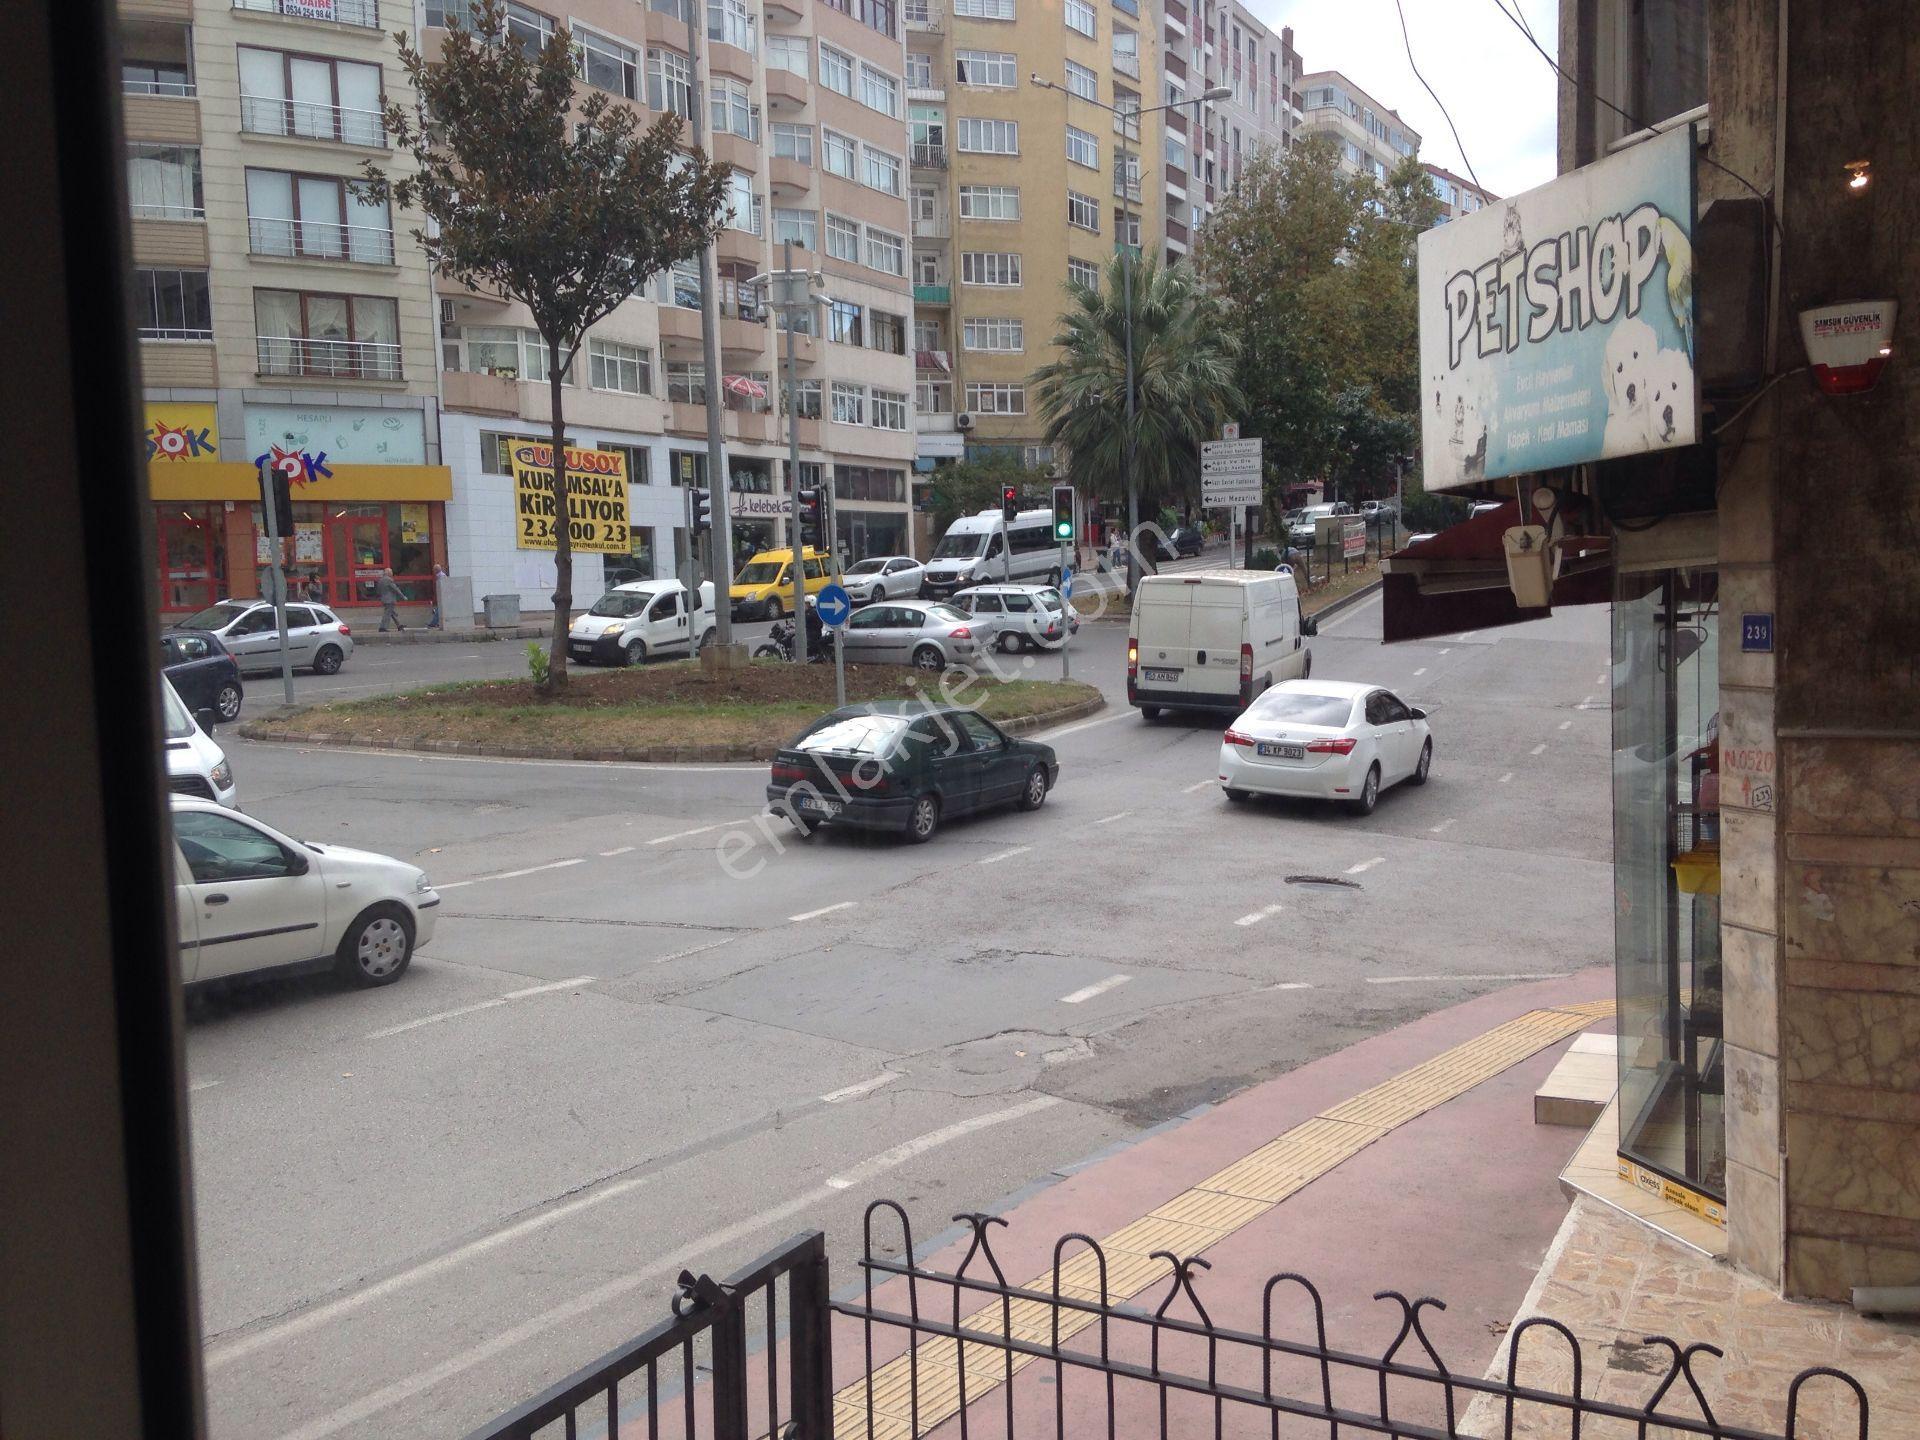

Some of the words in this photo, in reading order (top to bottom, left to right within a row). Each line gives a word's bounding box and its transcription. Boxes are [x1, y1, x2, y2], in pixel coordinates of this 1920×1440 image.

[286, 4, 302, 15] 0534
[315, 9, 324, 18] 98
[1445, 202, 1662, 370] PETSHOP
[1814, 317, 1842, 328] SAMSUN
[1507, 430, 1530, 450] Köpek
[531, 446, 622, 475] UUSOY
[518, 469, 624, 498] KURMSAL'A
[749, 498, 782, 514] kelebek
[569, 521, 595, 541] 00
[603, 524, 627, 542] 23
[1746, 625, 1768, 641] 239
[1640, 1173, 1661, 1191] axess
